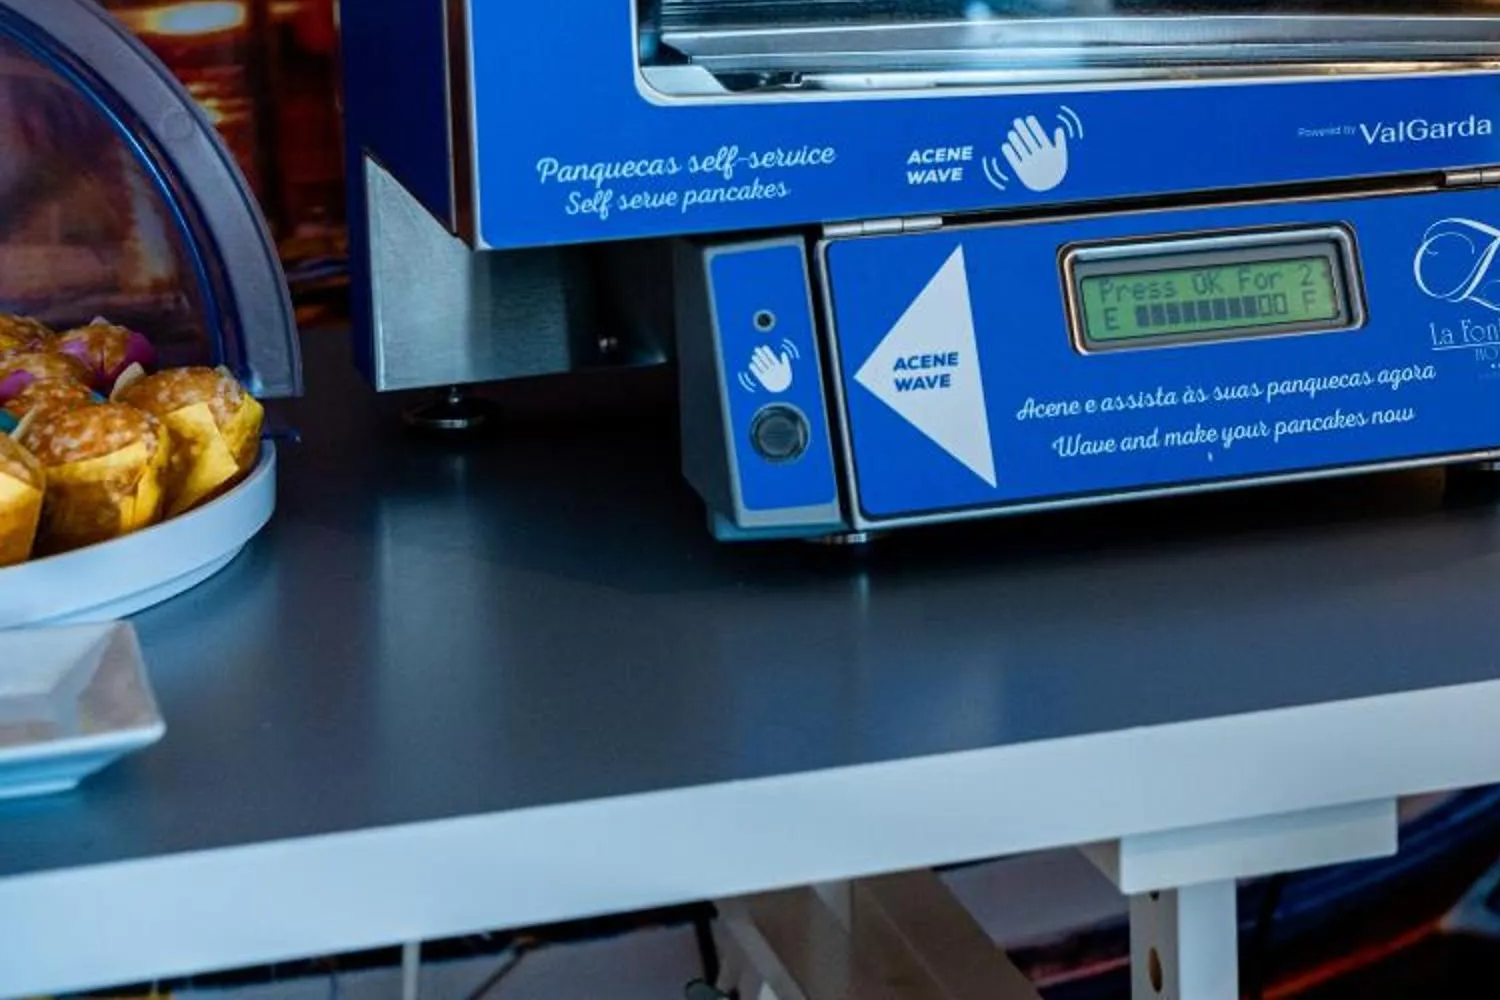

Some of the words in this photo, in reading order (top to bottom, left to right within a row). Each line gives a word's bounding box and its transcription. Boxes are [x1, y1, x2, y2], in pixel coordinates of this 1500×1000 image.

[1360, 115, 1492, 144] ValGarda
[537, 155, 682, 186] Panquecas
[688, 145, 835, 178] self-service
[907, 145, 974, 165] ACENE
[907, 167, 963, 185] WAVE
[566, 188, 614, 220] Self
[618, 188, 678, 213] serve
[682, 177, 787, 211] pancakes
[1099, 277, 1180, 303] Press
[1192, 273, 1220, 295] OK
[1238, 267, 1283, 291] For
[1297, 264, 1314, 286] 2
[1104, 307, 1119, 331] E
[1302, 289, 1316, 312] F
[892, 351, 960, 371] ACENE
[893, 372, 952, 393] WAVE
[1015, 397, 1082, 422] Acene
[1084, 398, 1098, 414] e
[1100, 386, 1178, 412] assista
[1182, 383, 1208, 405] às
[1213, 382, 1263, 402] suas
[1266, 368, 1373, 405] panquecas
[1377, 363, 1437, 397] agora
[1051, 429, 1117, 458] Wave
[1120, 428, 1160, 453] and
[1163, 424, 1219, 449] make
[1221, 420, 1270, 450] your
[1274, 406, 1369, 441] pancakes
[1372, 405, 1416, 426] now
